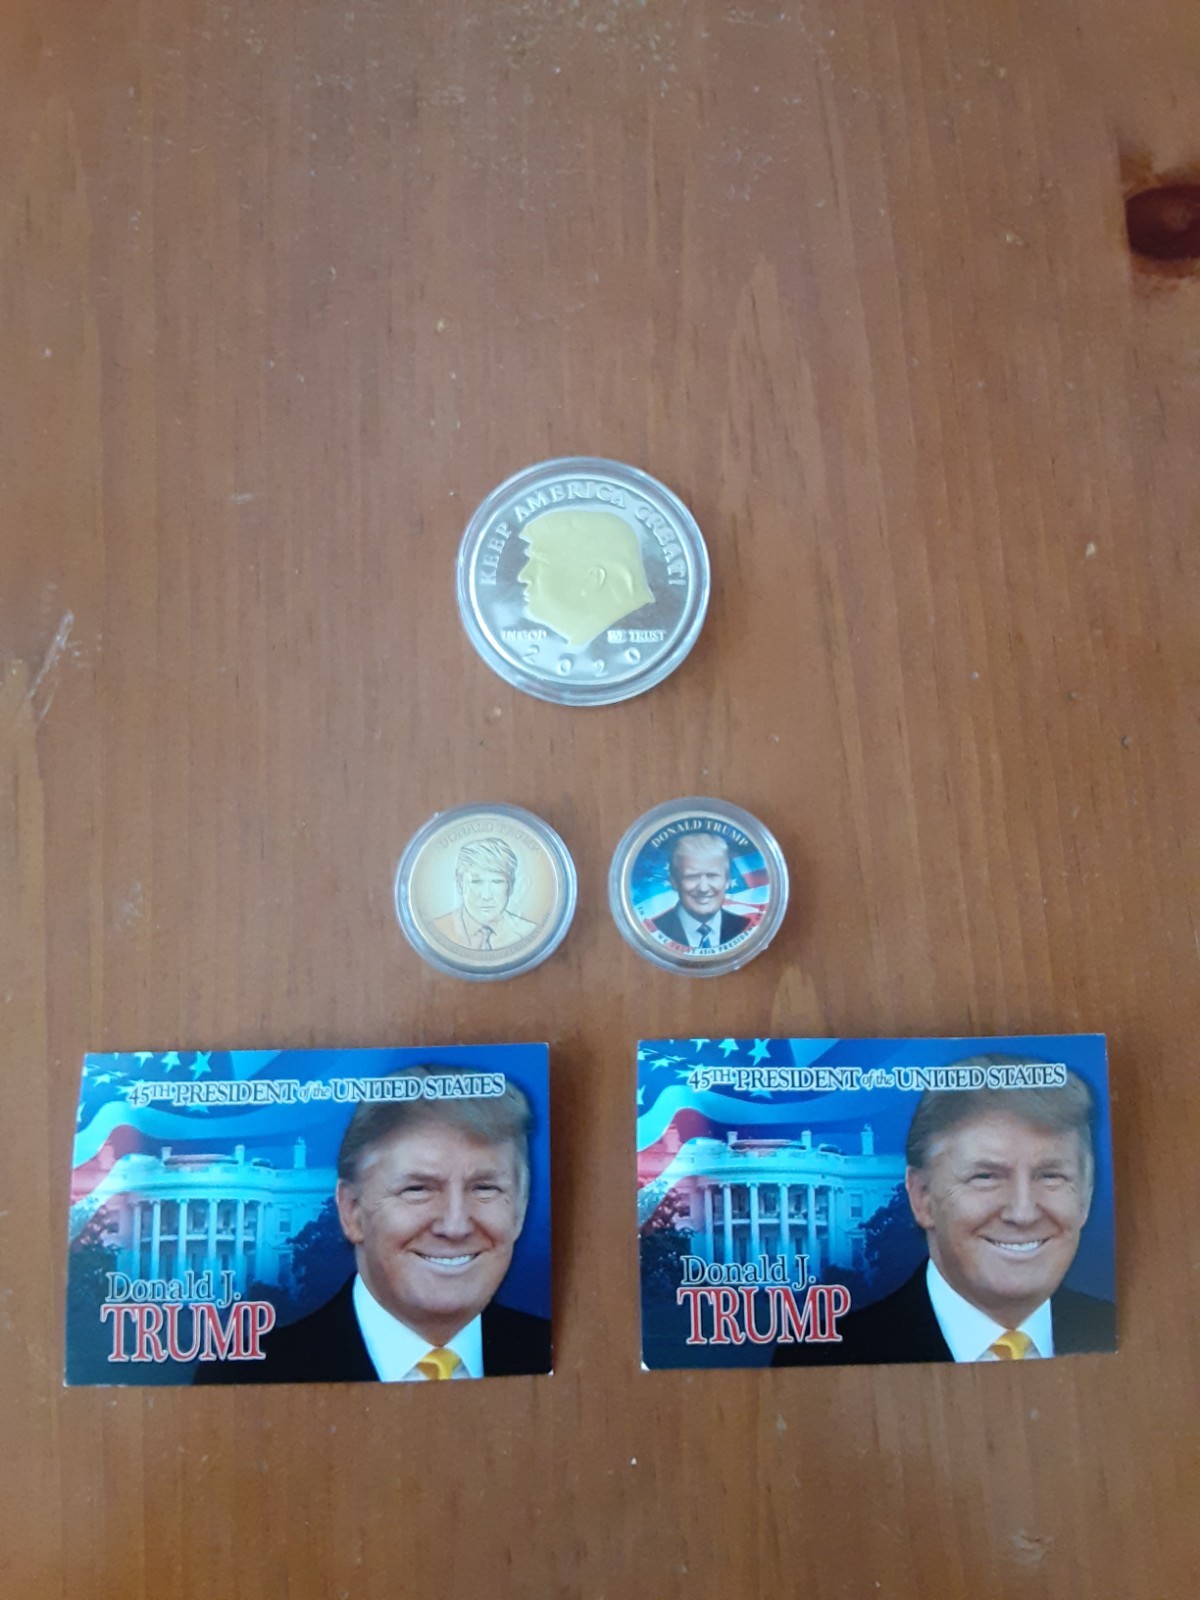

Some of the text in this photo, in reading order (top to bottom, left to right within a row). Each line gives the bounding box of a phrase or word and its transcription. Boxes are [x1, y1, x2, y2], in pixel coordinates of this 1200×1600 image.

[480, 522, 513, 587] KEEP
[514, 481, 627, 523] AMERICA
[628, 629, 667, 643] TRUST
[650, 819, 749, 849] DONALD TRUMP
[173, 1080, 299, 1106] PRESIDENT
[299, 1082, 313, 1102] of
[312, 1081, 331, 1099] the
[331, 1077, 421, 1103] UNITED
[424, 1074, 505, 1099] STATES
[734, 1067, 861, 1091] PRESIDENT
[861, 1068, 876, 1089] of
[874, 1068, 894, 1086] the
[894, 1066, 985, 1091] UNITED
[987, 1064, 1065, 1088] STATES
[105, 1270, 241, 1308] Donald J.
[680, 1254, 816, 1291] Donald J.
[100, 1301, 276, 1363] TRUMP
[677, 1285, 851, 1345] TRUMP
